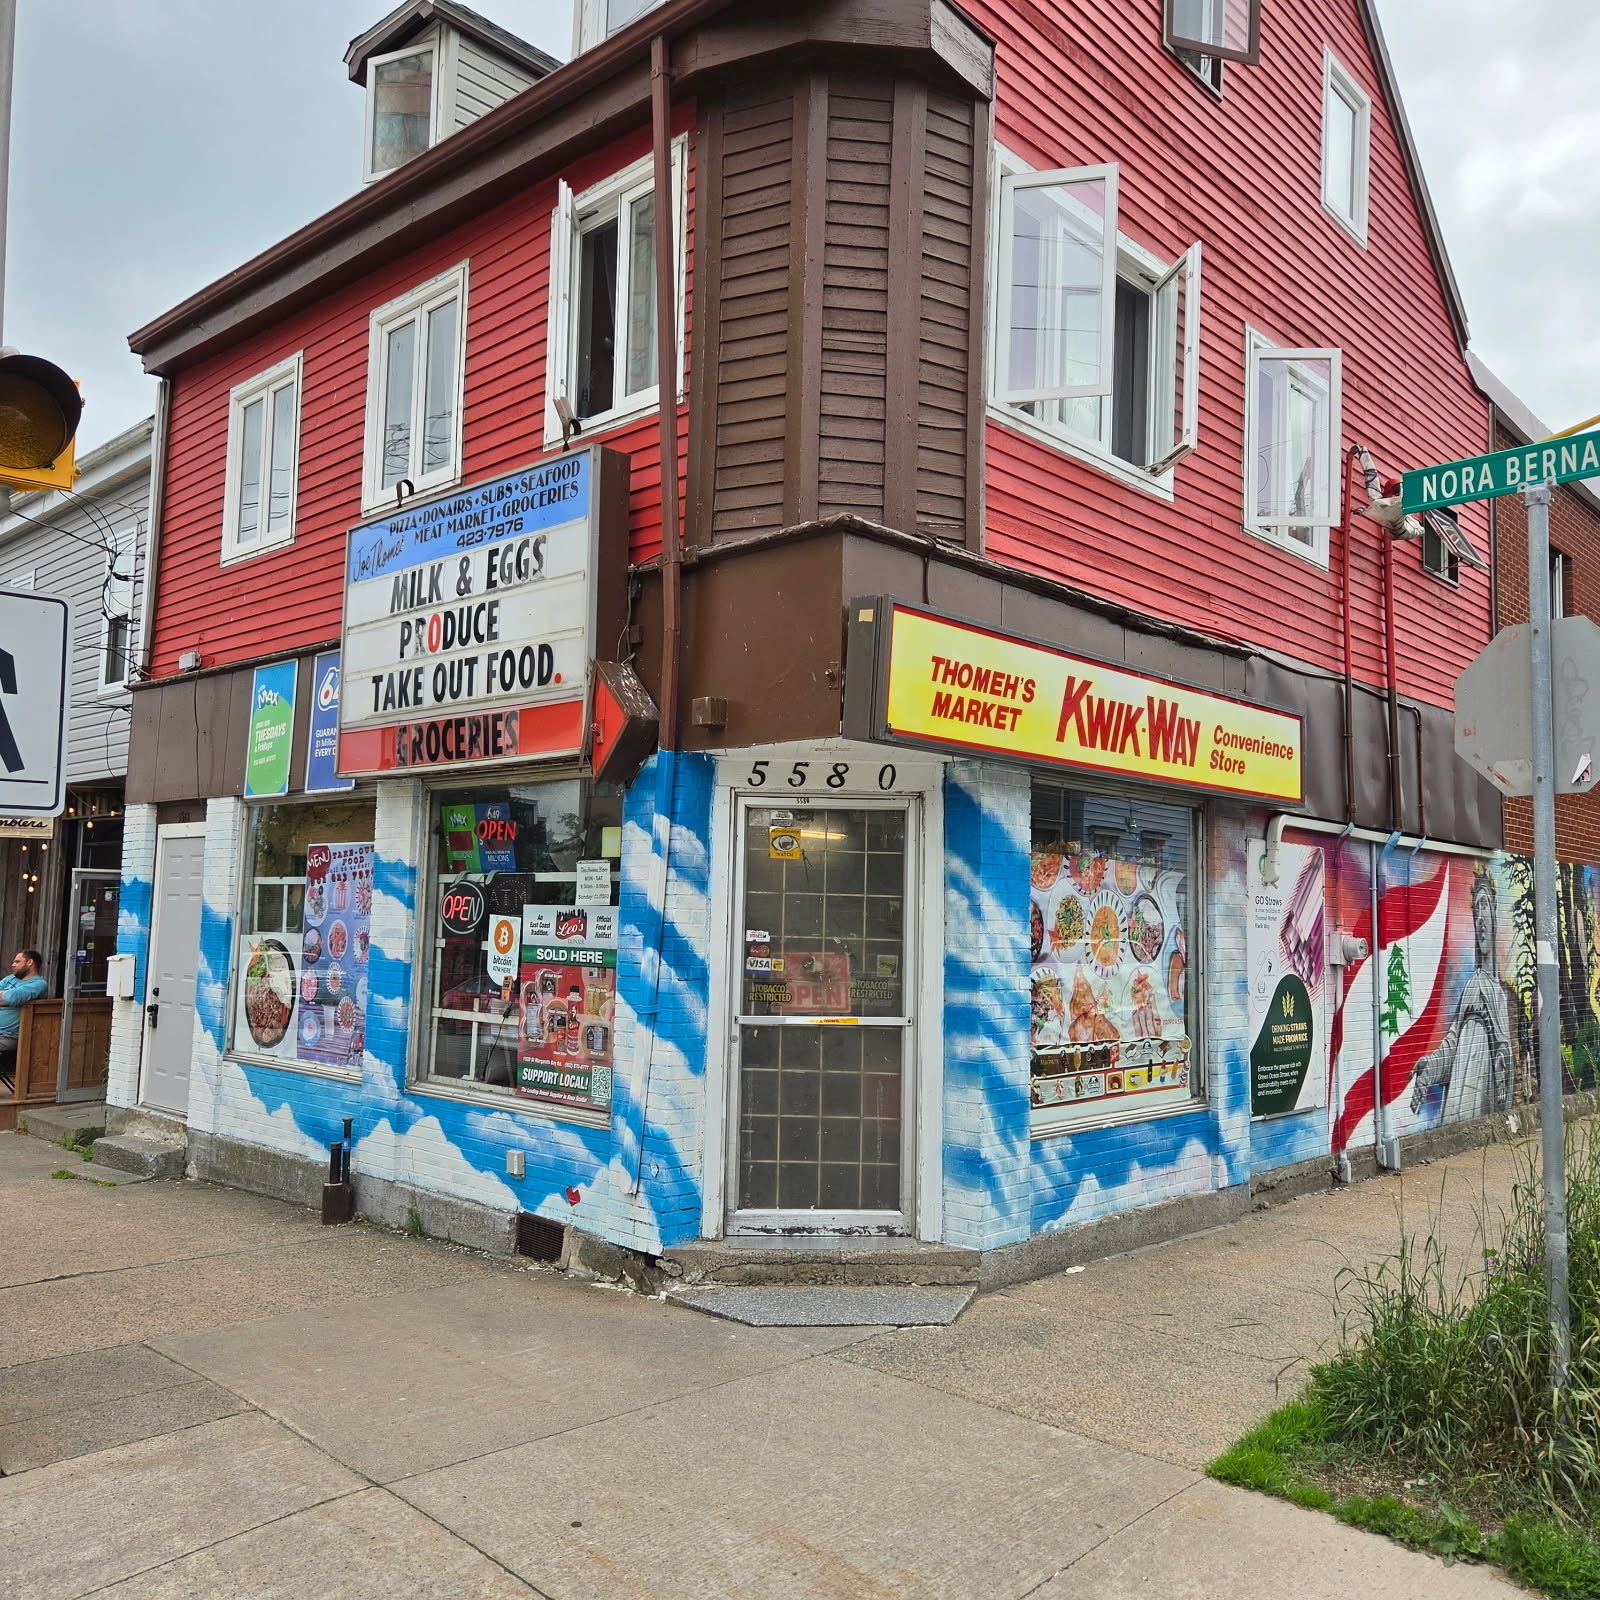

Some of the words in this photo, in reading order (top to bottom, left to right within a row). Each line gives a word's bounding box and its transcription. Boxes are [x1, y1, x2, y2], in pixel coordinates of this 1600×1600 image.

[1422, 462, 1494, 503] NORA
[1505, 439, 1600, 486] BERNA
[389, 515, 418, 536] PIZZA
[423, 495, 473, 525] DONAIRS
[480, 482, 513, 507] SUBS
[519, 460, 580, 494] SEAFOOD
[414, 522, 444, 546] MEAT
[447, 505, 497, 536] MARKET
[502, 480, 579, 517] GROCERIES
[353, 546, 371, 582] Joe
[390, 563, 443, 613] MILK
[456, 556, 473, 596] &
[486, 534, 547, 590] EGGS
[399, 600, 499, 658] PRODUCE
[371, 666, 424, 712] TAKE
[433, 656, 478, 702] OUT
[931, 655, 1036, 703] THOMEH'S
[930, 691, 1023, 732] MARKET
[255, 723, 287, 743] TUESDAYS
[397, 710, 519, 766] GROCERIES
[1213, 724, 1294, 761] Convenience
[314, 747, 331, 758] EVERY
[1209, 749, 1246, 775] Store
[476, 819, 517, 841] OPEN
[307, 849, 330, 868] MENU
[341, 855, 365, 867] FOOD
[488, 888, 528, 906] ATM
[1254, 895, 1265, 905] GO
[1265, 896, 1283, 906] Straws
[442, 895, 480, 921] OPEN
[529, 921, 539, 929] East
[556, 920, 584, 937] Leo's
[595, 923, 606, 931] Food
[492, 955, 512, 967] bitcoin
[536, 948, 568, 962] SOLD
[570, 950, 603, 964] HERE
[749, 959, 770, 969] VISA
[754, 983, 786, 993] TOBACCO
[851, 989, 893, 999] RESTRICTED
[856, 980, 887, 989] TOBACCO
[749, 992, 792, 1002] RESTRICTED
[790, 984, 847, 1008] PEN
[1271, 1023, 1290, 1034] DRINKING
[1290, 1022, 1308, 1032] STRAWS
[1272, 1035, 1286, 1045] MADE
[1285, 1033, 1298, 1044] FROM
[522, 1067, 559, 1085] SUPPORT
[559, 1073, 589, 1090] LOCAL!
